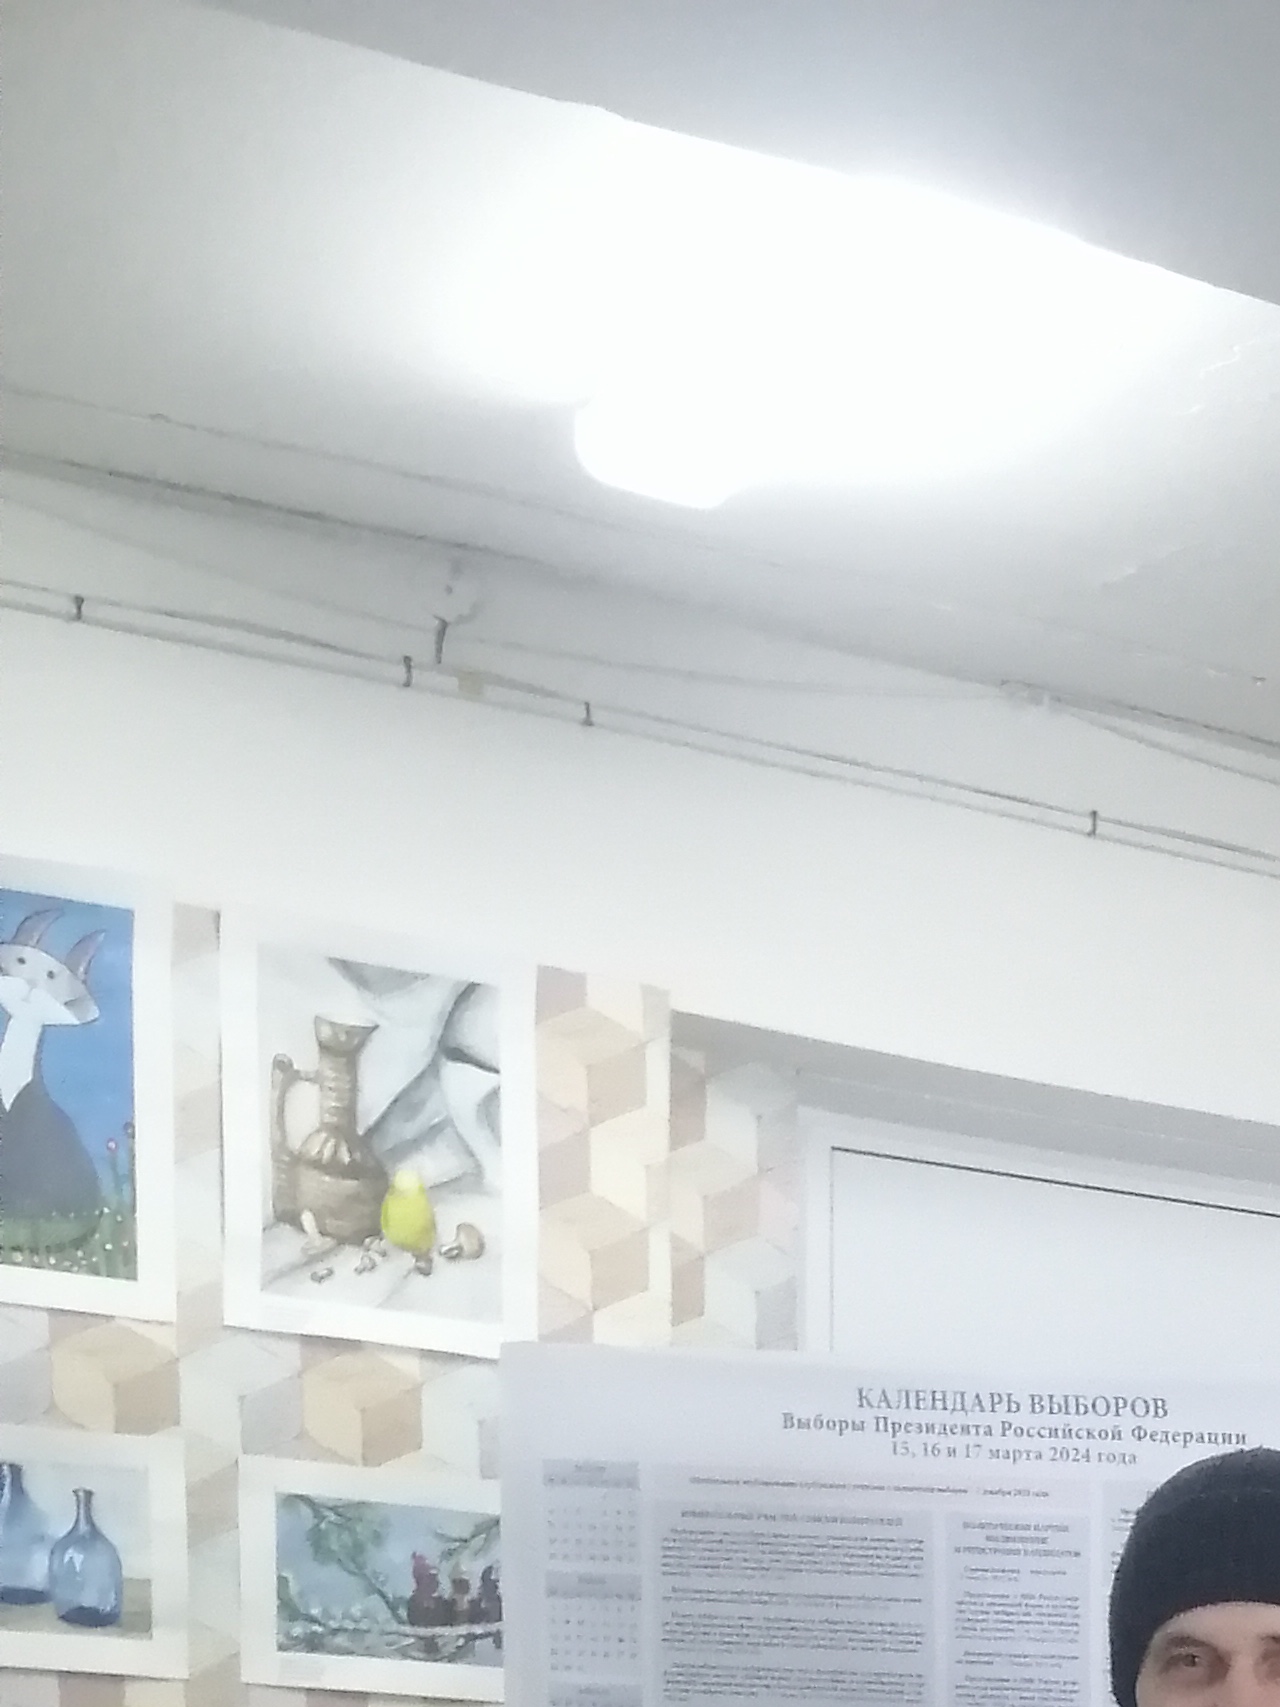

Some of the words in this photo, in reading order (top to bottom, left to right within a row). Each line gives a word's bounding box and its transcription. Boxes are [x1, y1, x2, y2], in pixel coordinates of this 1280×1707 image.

[857, 1387, 1021, 1415] КАЛЕНДАРЬ
[1029, 1393, 1169, 1419] ВЫБОРОВ
[782, 1412, 866, 1433] Выборы
[874, 1416, 993, 1438] Президента
[1000, 1421, 1123, 1442] Российской
[1131, 1425, 1248, 1447] Федерации
[890, 1441, 916, 1459] 15,
[922, 1442, 941, 1457] 16
[947, 1446, 957, 1458] и
[965, 1444, 983, 1459] 17
[988, 1448, 1043, 1464] марта
[1048, 1446, 1091, 1463] 2024
[1097, 1452, 1138, 1467] года
